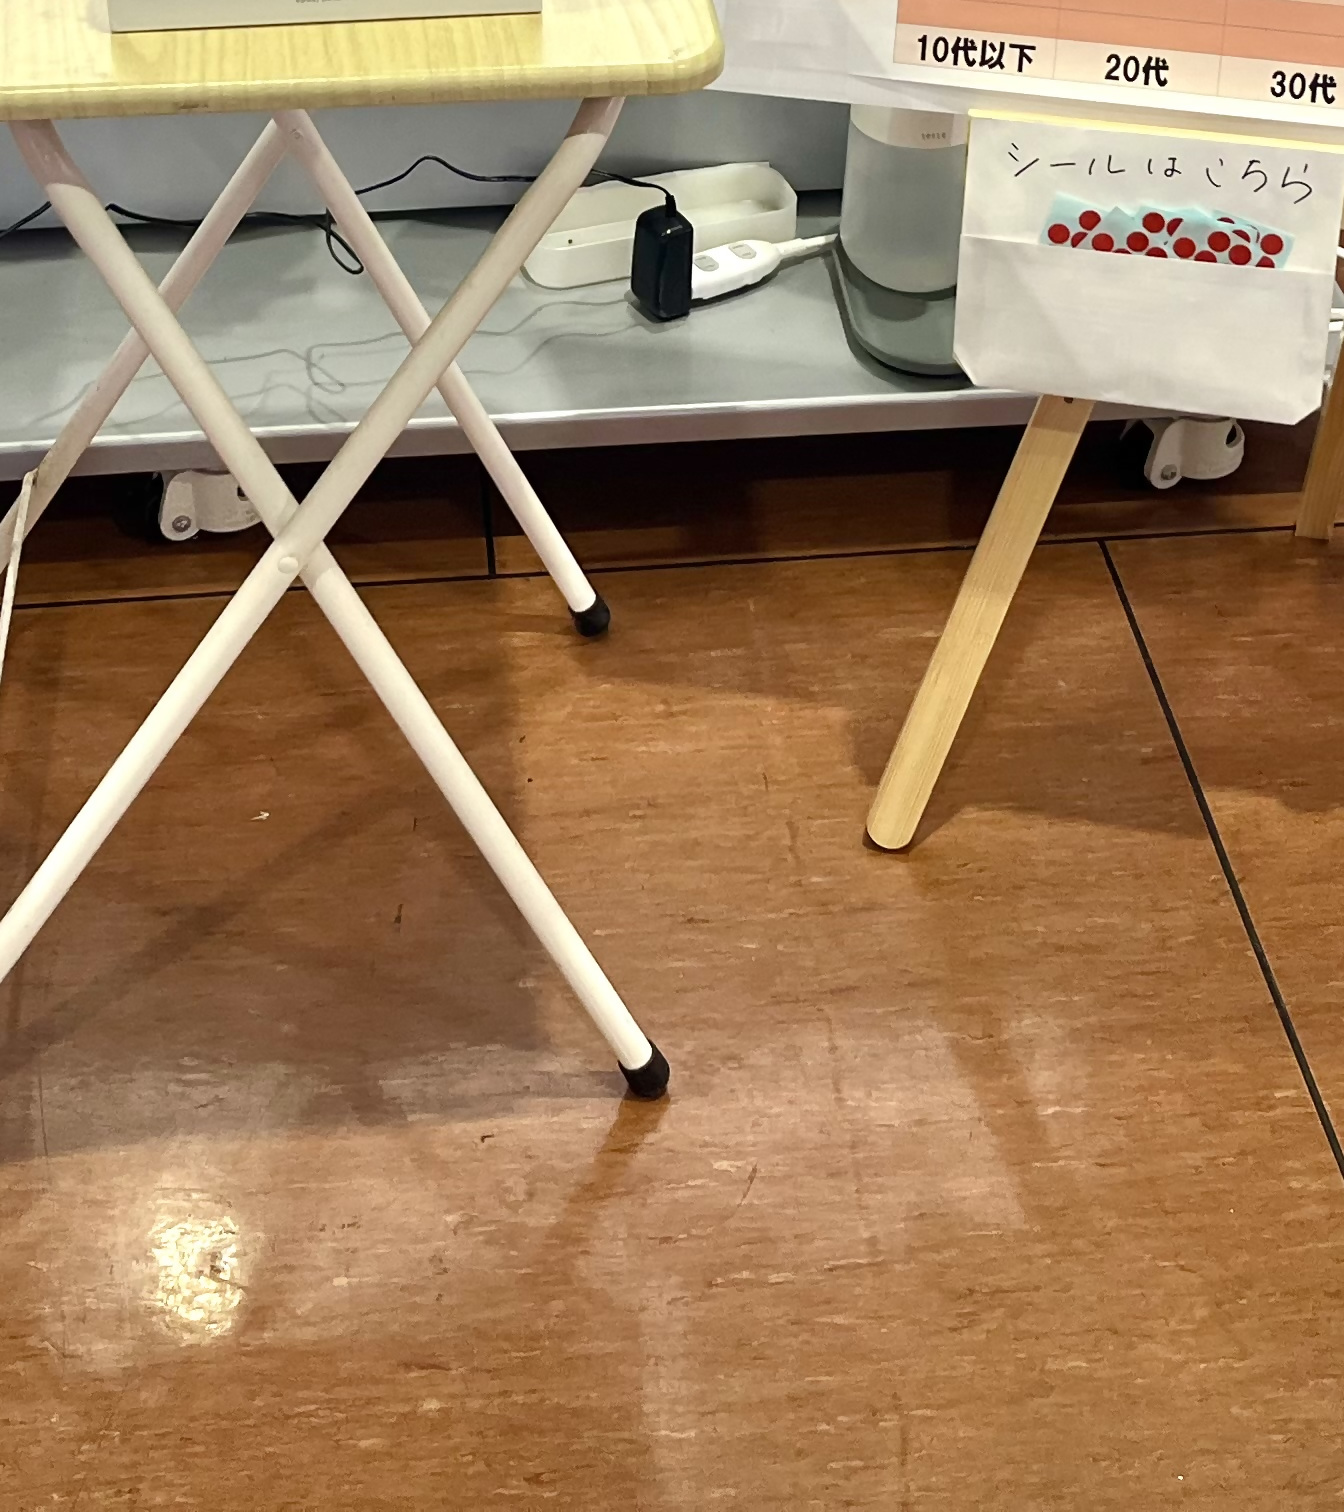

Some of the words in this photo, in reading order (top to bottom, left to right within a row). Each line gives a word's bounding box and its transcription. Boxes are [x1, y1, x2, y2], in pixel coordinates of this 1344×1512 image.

[916, 34, 1036, 74] 10代以下
[1105, 54, 1170, 88] 20代
[1270, 70, 1337, 105] 30代
